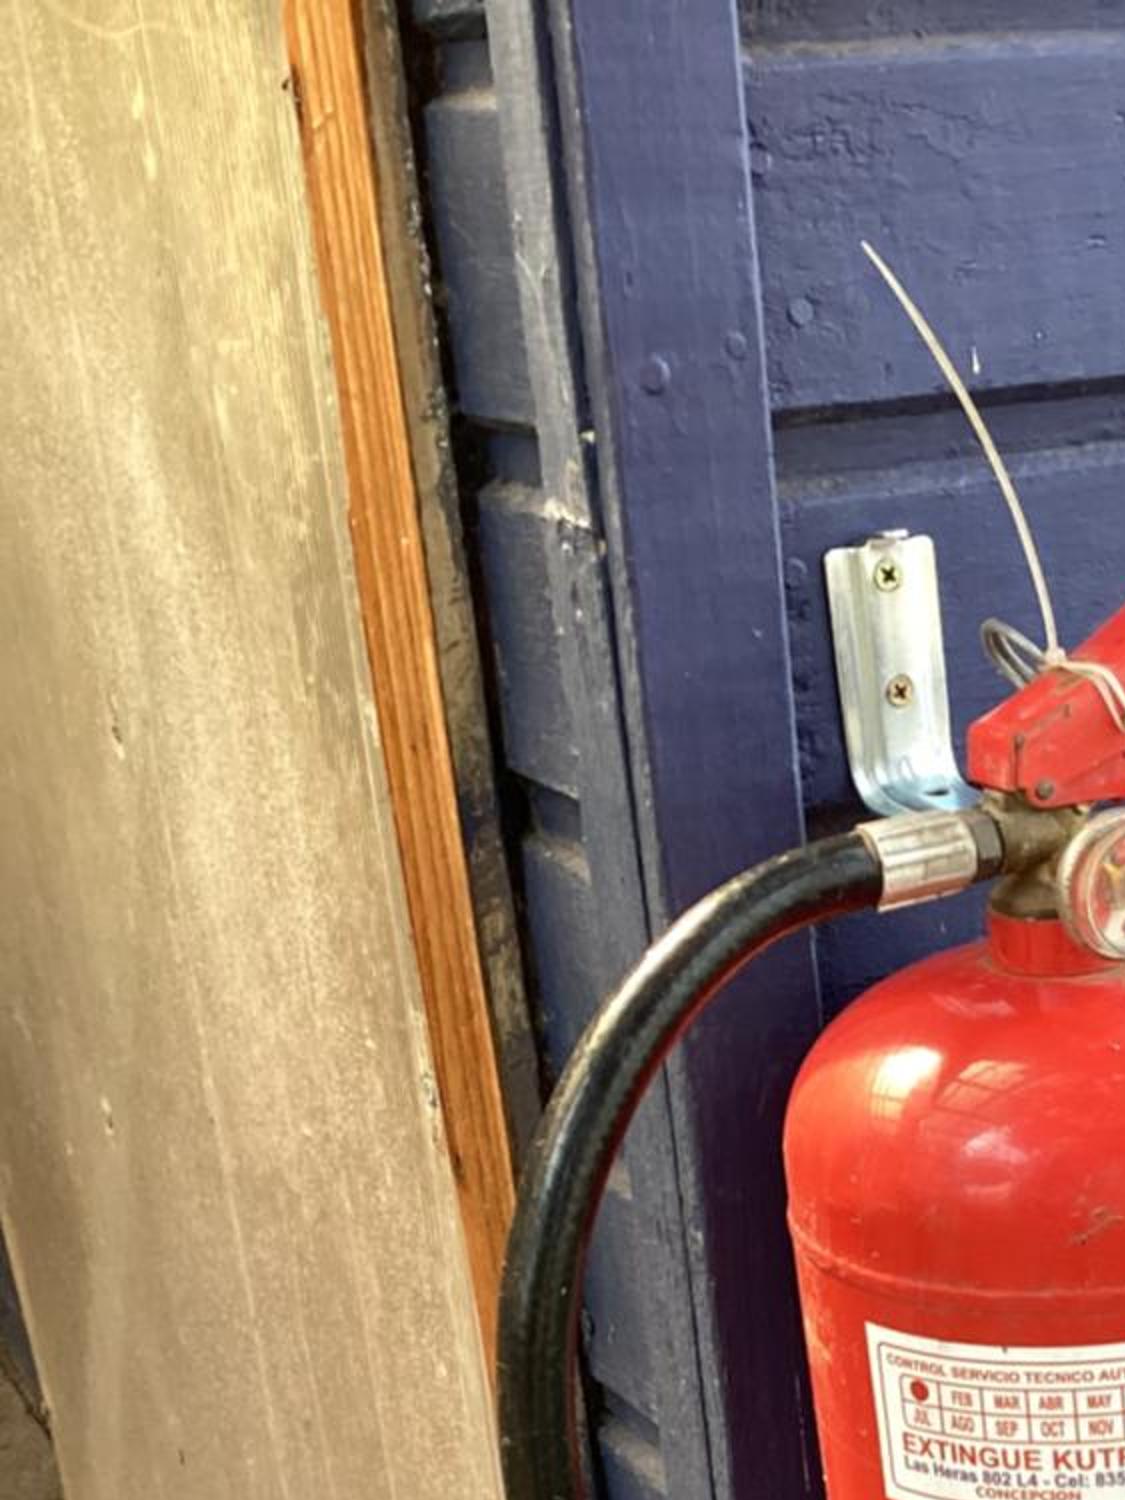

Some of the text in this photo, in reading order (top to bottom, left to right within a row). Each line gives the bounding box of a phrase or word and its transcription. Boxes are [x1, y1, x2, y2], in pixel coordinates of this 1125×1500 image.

[886, 1351, 947, 1377] CONTROL
[951, 1366, 1020, 1384] SERVICIO
[1025, 1370, 1095, 1384] TECNICO
[951, 1390, 973, 1407] FEB
[993, 1394, 1020, 1409] MAR
[1038, 1396, 1064, 1410] ABR
[1086, 1394, 1112, 1409] MAY
[951, 1415, 975, 1433] AGO
[995, 1420, 1018, 1436] SEP
[1039, 1421, 1065, 1437] OCT
[1087, 1420, 1114, 1435] NOV
[902, 1430, 1043, 1471] EXTINGUE
[903, 1454, 930, 1473] Las
[933, 1461, 978, 1483] Heras
[981, 1471, 1012, 1487] 802
[1016, 1474, 1038, 1488] L4
[1054, 1472, 1090, 1488] Cel:
